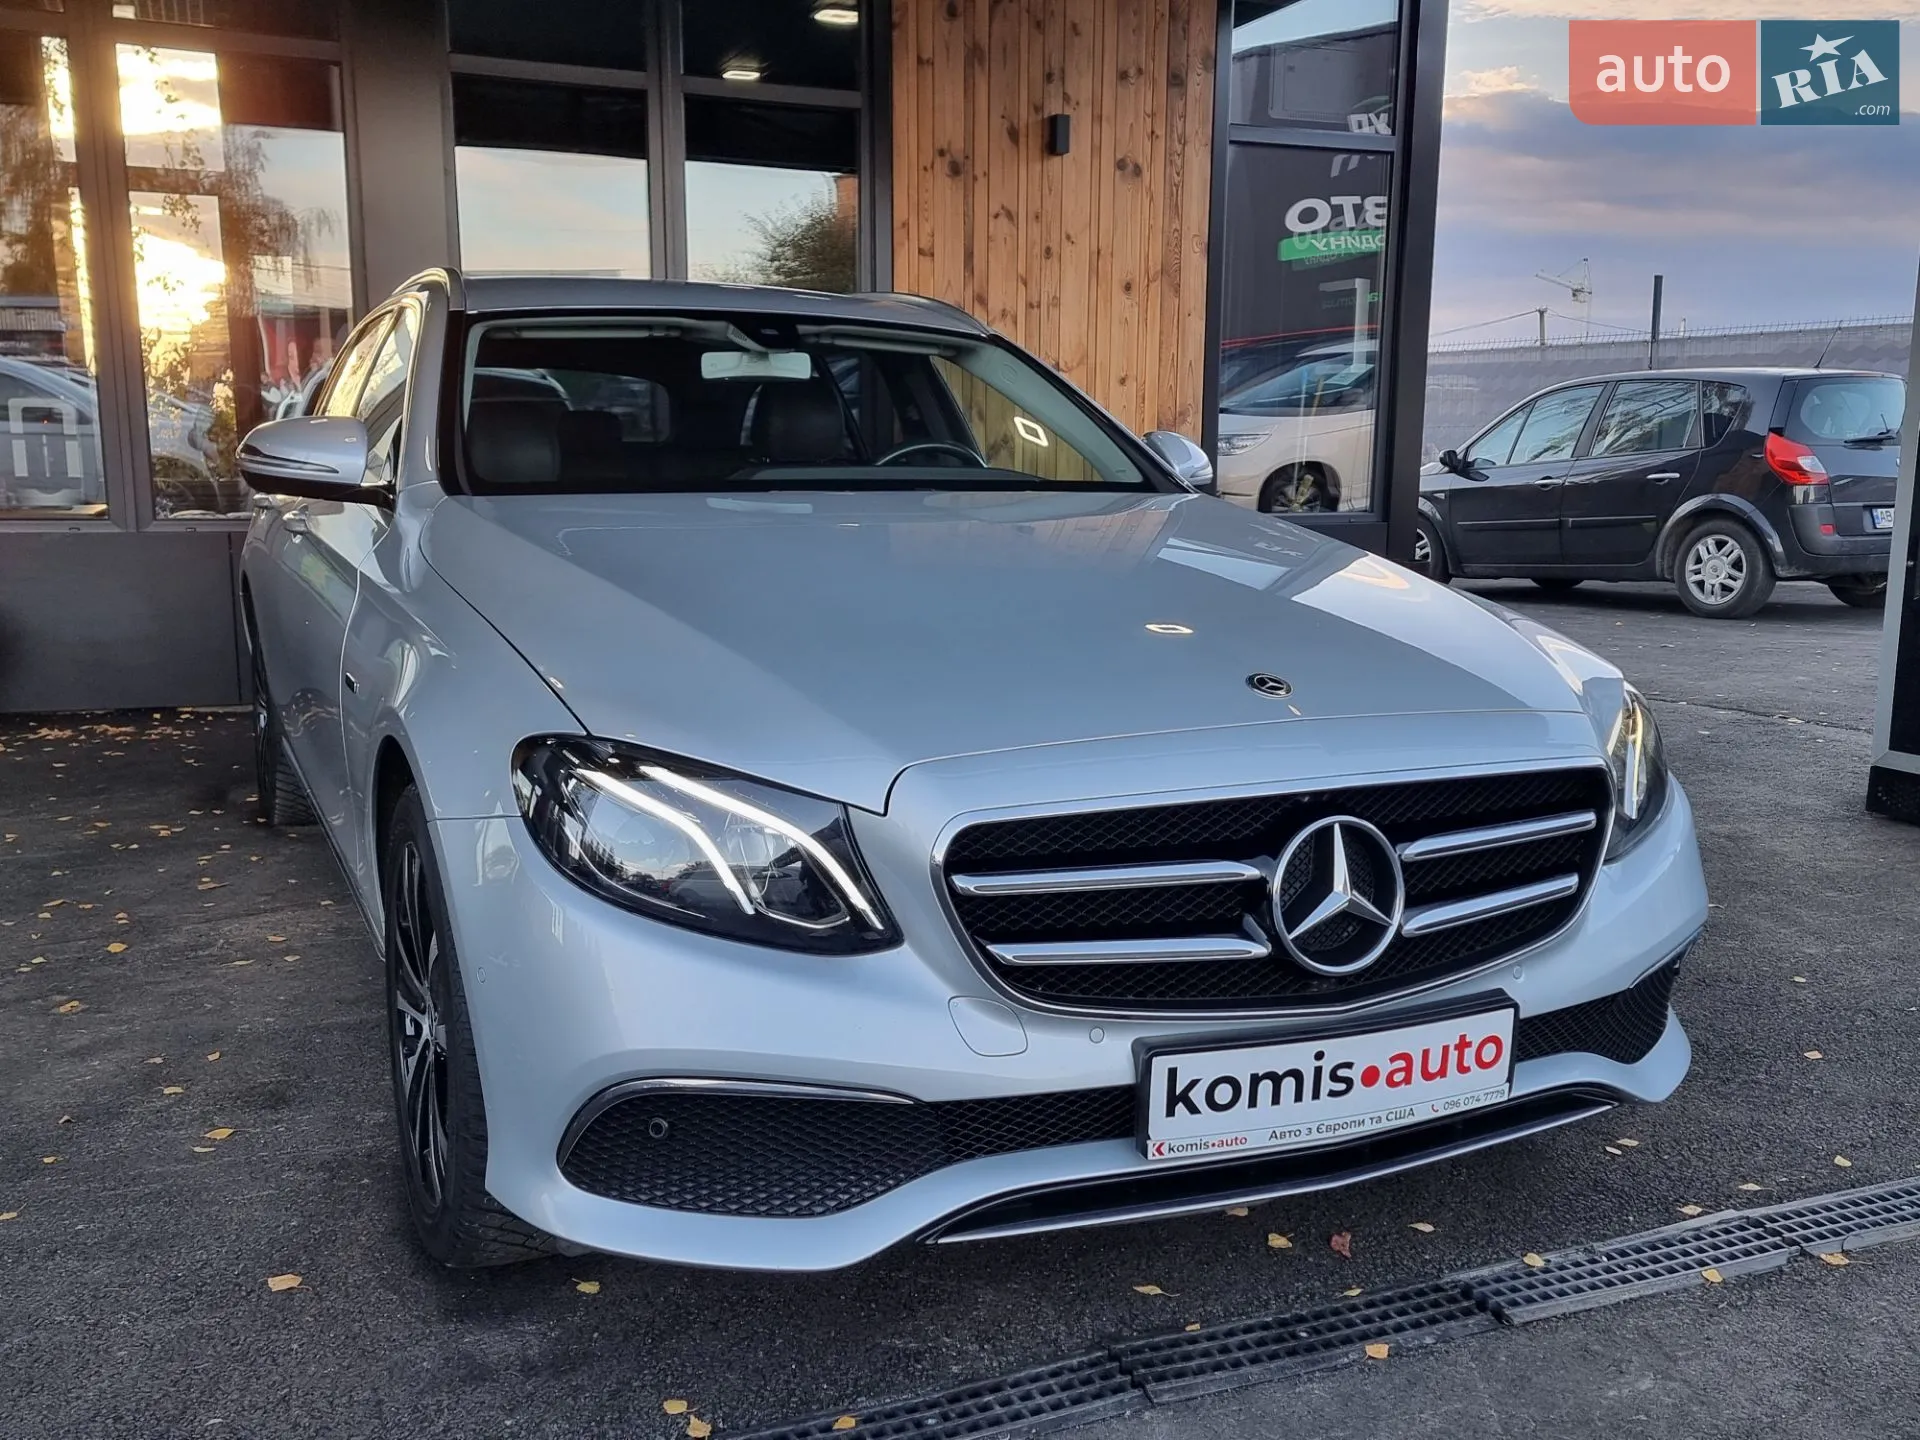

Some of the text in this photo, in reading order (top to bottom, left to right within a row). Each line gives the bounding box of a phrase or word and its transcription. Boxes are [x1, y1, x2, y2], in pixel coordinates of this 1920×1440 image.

[1443, 1088, 1506, 1111] 096 074 7779
[1268, 1128, 1302, 1141] Авто
[1316, 1118, 1366, 1138] Європи
[1369, 1115, 1383, 1126] та
[1385, 1107, 1416, 1121] США
